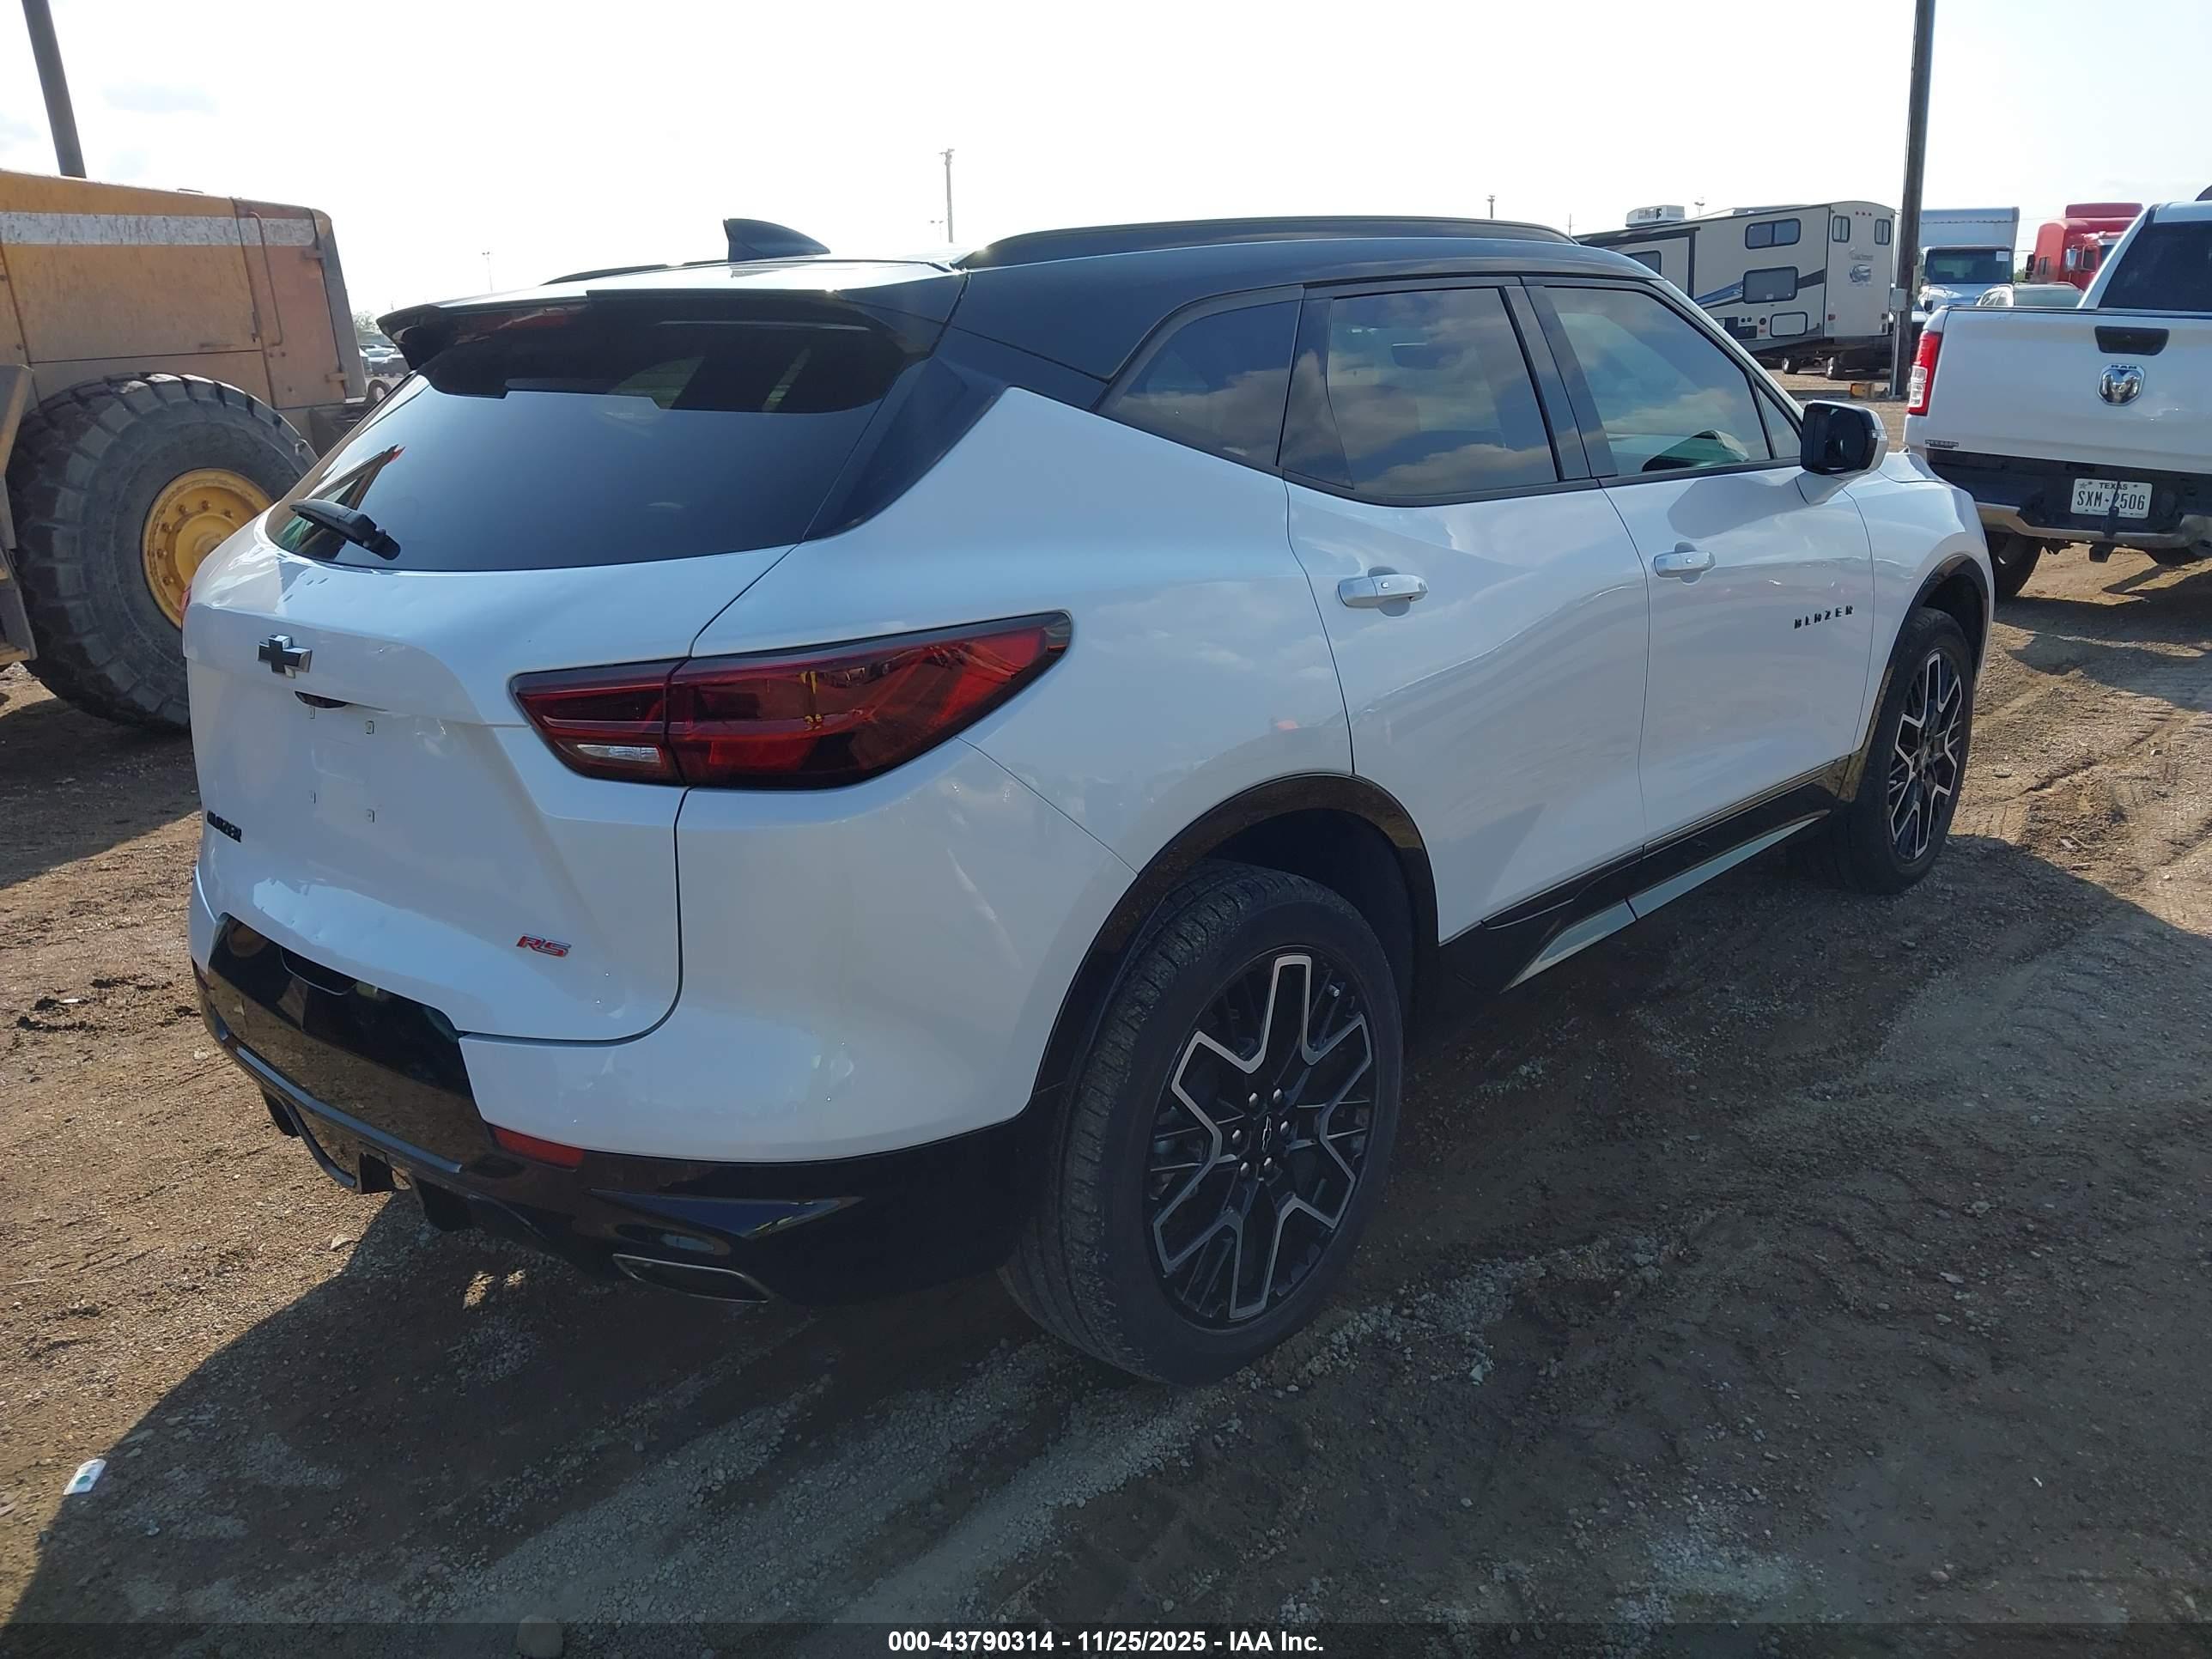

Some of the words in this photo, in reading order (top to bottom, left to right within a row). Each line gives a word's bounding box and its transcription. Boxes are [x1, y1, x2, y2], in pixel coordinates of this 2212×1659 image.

[2099, 482, 2129, 490] TEXAS
[1793, 605, 1854, 629] BLAZER
[515, 934, 572, 957] RS
